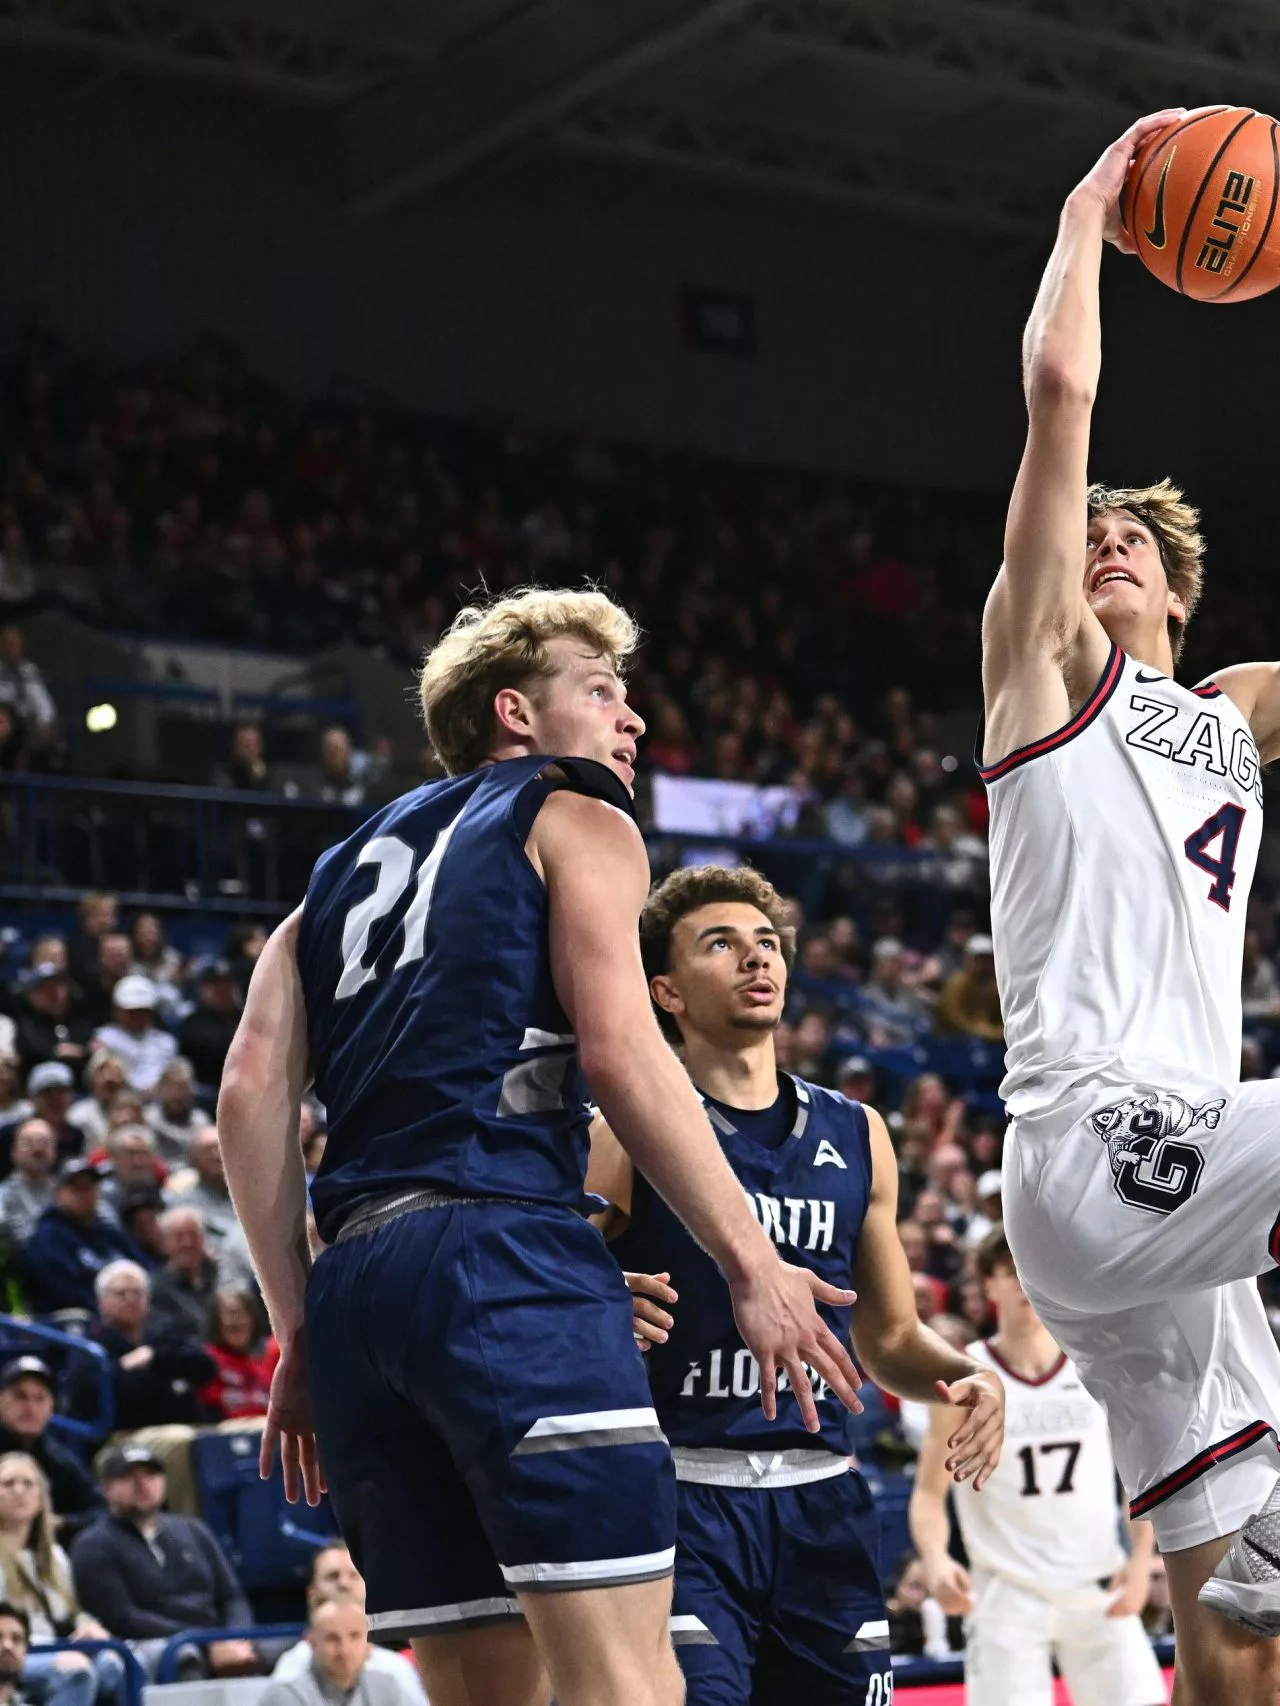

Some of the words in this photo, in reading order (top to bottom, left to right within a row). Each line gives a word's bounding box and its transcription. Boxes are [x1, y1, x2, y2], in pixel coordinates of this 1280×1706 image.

[1194, 169, 1256, 275] ELITE
[334, 806, 468, 1001] 21
[1184, 801, 1247, 913] 4
[744, 1191, 836, 1252] RTH
[1017, 1440, 1082, 1497] 17
